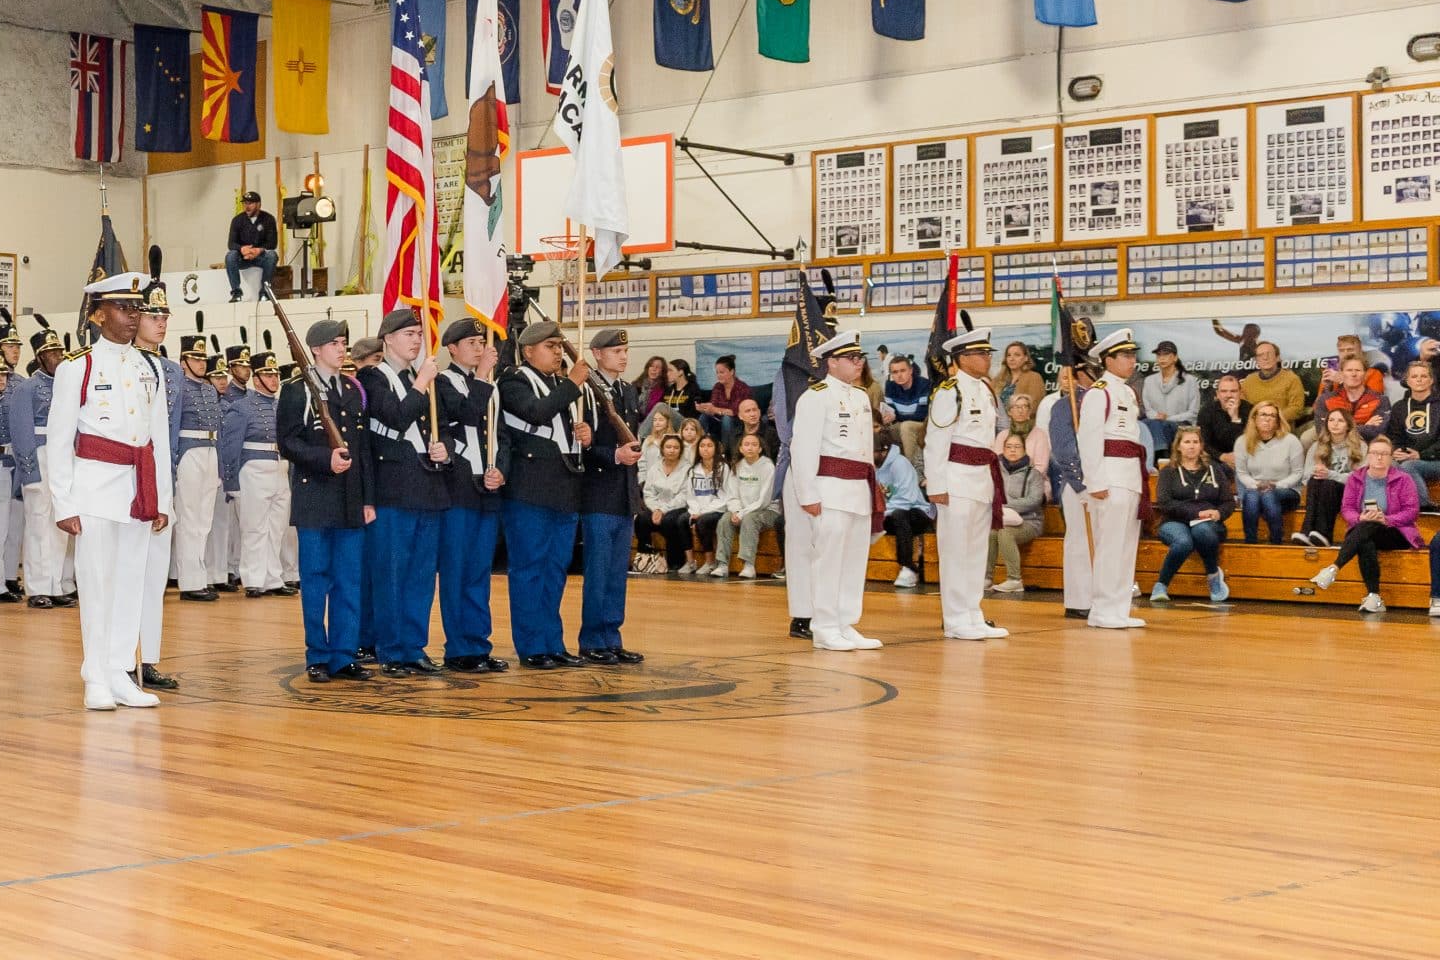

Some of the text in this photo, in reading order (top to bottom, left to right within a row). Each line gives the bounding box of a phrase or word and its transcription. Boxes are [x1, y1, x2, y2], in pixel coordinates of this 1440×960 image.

[1211, 358, 1261, 374] ingredi
[1281, 360, 1299, 370] on
[1302, 359, 1312, 369] a
